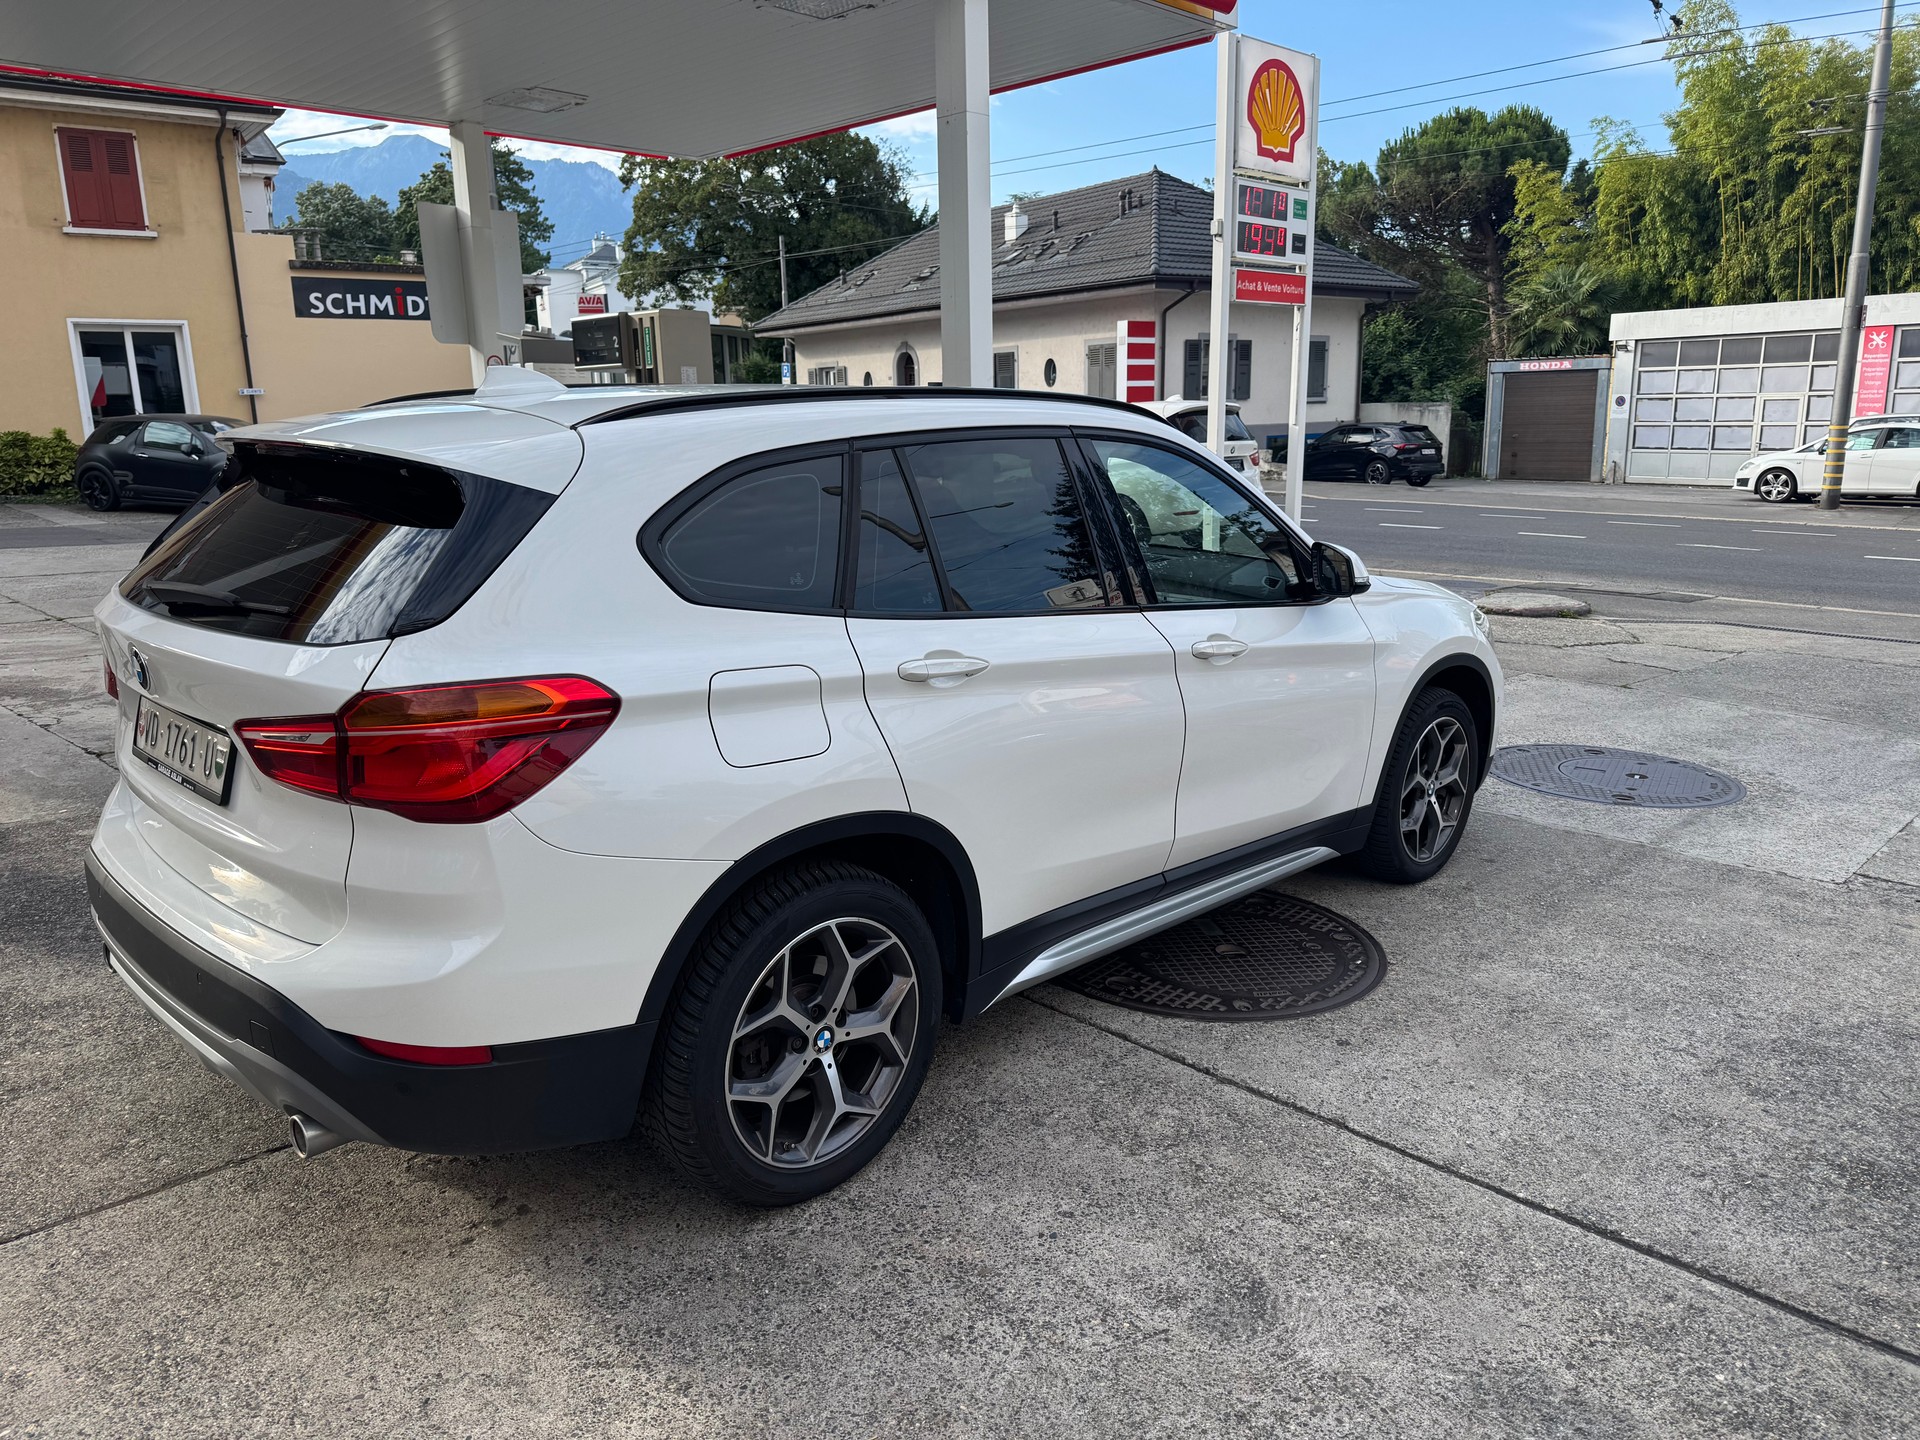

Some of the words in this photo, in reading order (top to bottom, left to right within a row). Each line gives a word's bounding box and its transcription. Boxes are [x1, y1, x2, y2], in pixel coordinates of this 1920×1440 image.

[1237, 280, 1255, 291] Achat
[1256, 281, 1262, 292] &
[1263, 282, 1281, 293] Vente
[1282, 284, 1304, 295] Voiture
[309, 287, 429, 317] SCHMiD
[612, 335, 619, 348] 2
[1520, 361, 1572, 370] HONDA
